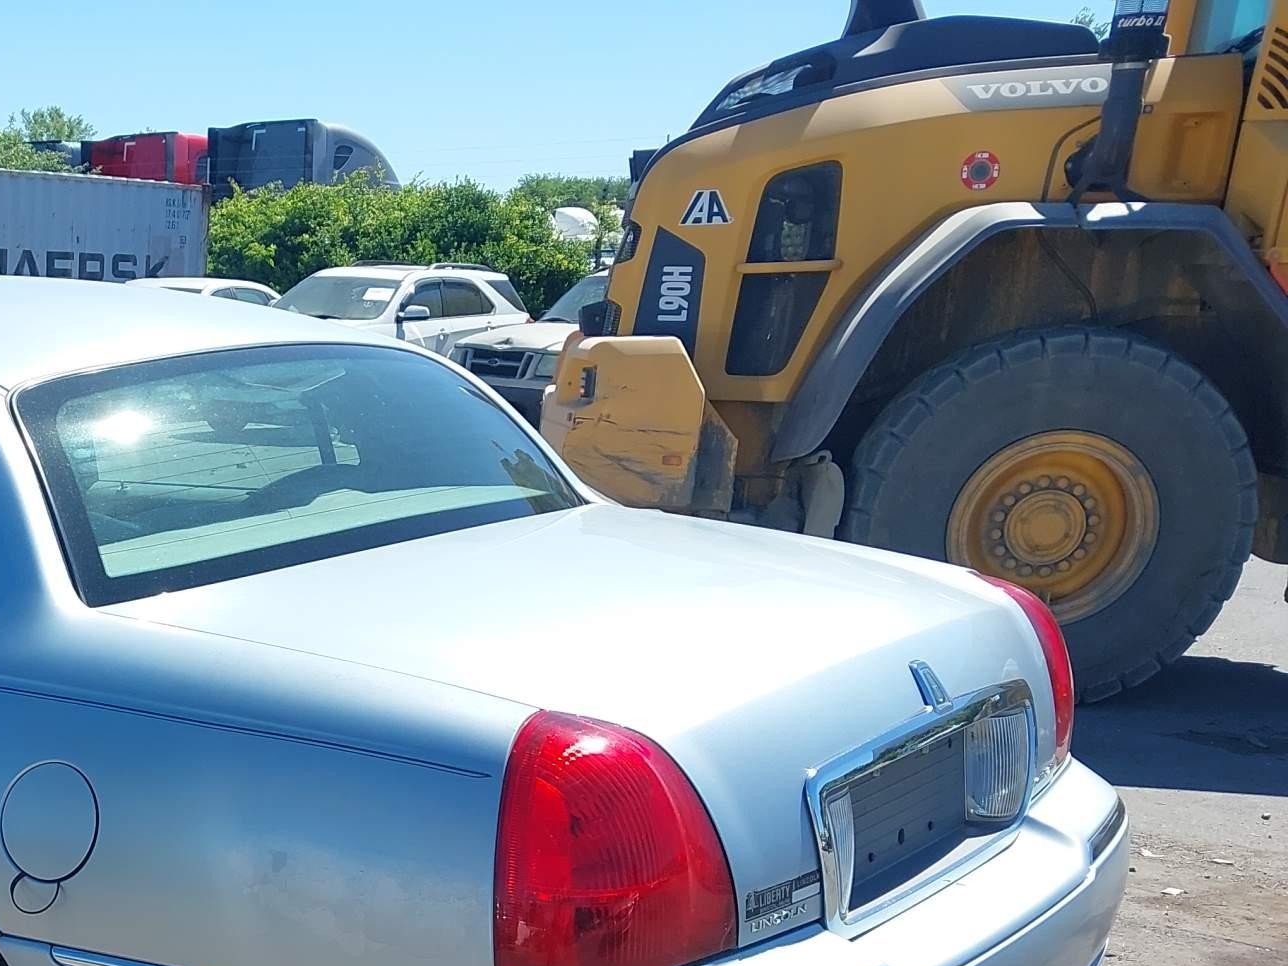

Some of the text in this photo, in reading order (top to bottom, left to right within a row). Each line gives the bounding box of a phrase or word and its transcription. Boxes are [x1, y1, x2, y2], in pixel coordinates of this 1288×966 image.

[1117, 18, 1153, 28] turbo
[967, 77, 1108, 99] VOLVO
[657, 265, 694, 322] L90H
[759, 885, 790, 907] LIBERTY
[750, 903, 807, 932] LINCOLN
